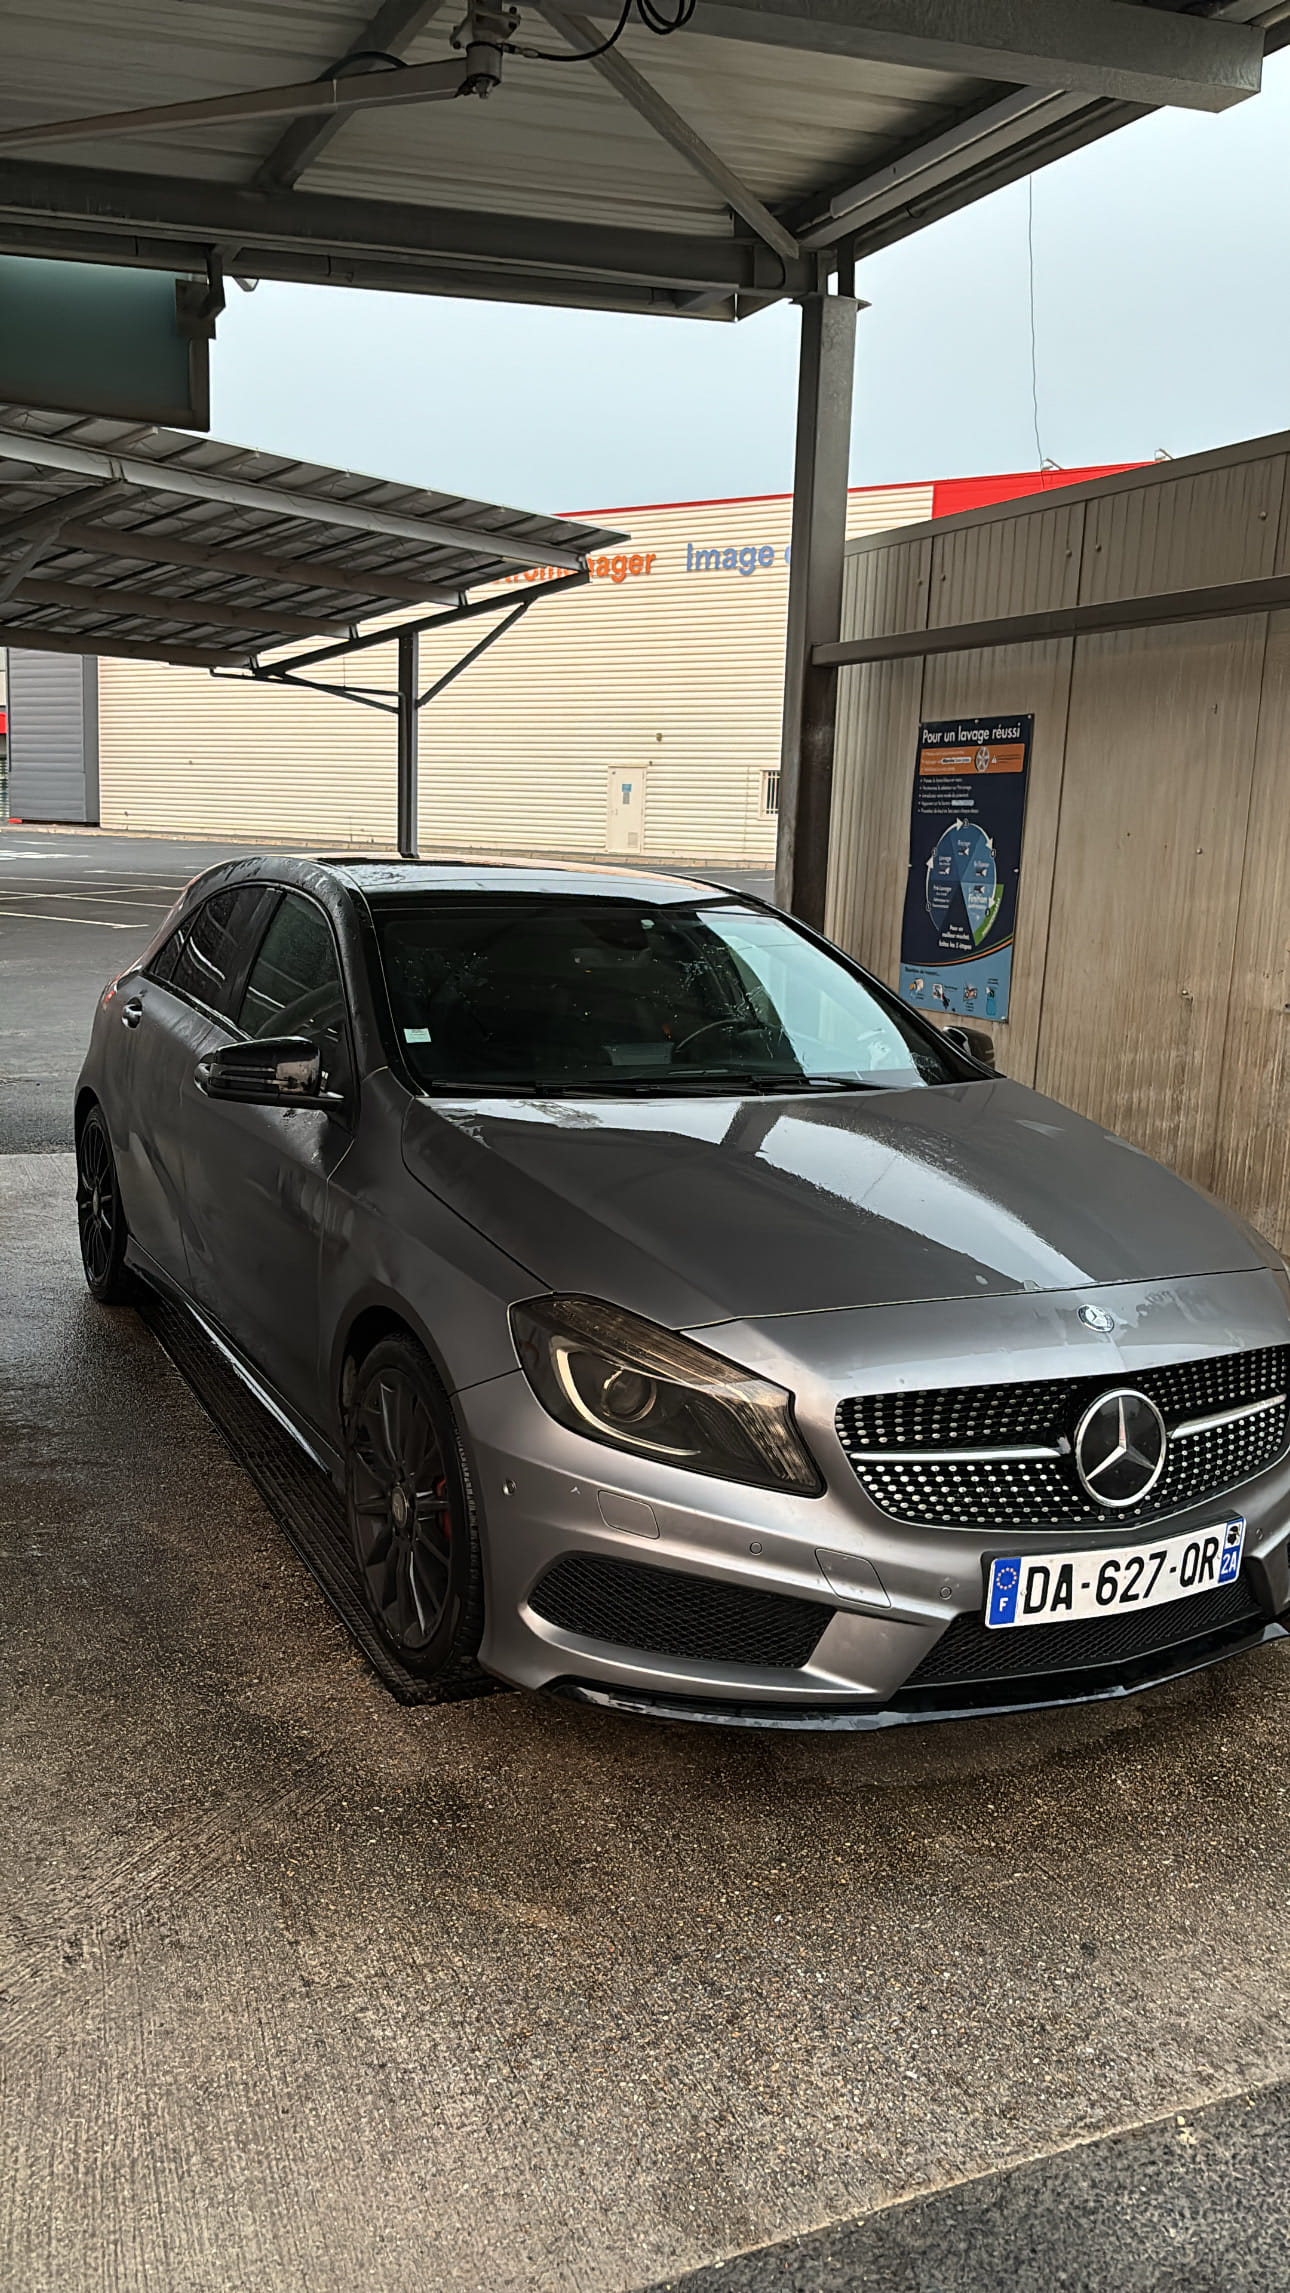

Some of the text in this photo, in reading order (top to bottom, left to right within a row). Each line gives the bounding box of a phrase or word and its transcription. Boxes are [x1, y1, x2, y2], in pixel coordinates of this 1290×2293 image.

[686, 542, 775, 576] Image
[922, 722, 1021, 744] Pour un lavage réussi
[1220, 1551, 1238, 1575] 2A
[1022, 1536, 1220, 1615] DA-627-QR
[999, 1597, 1009, 1612] F
